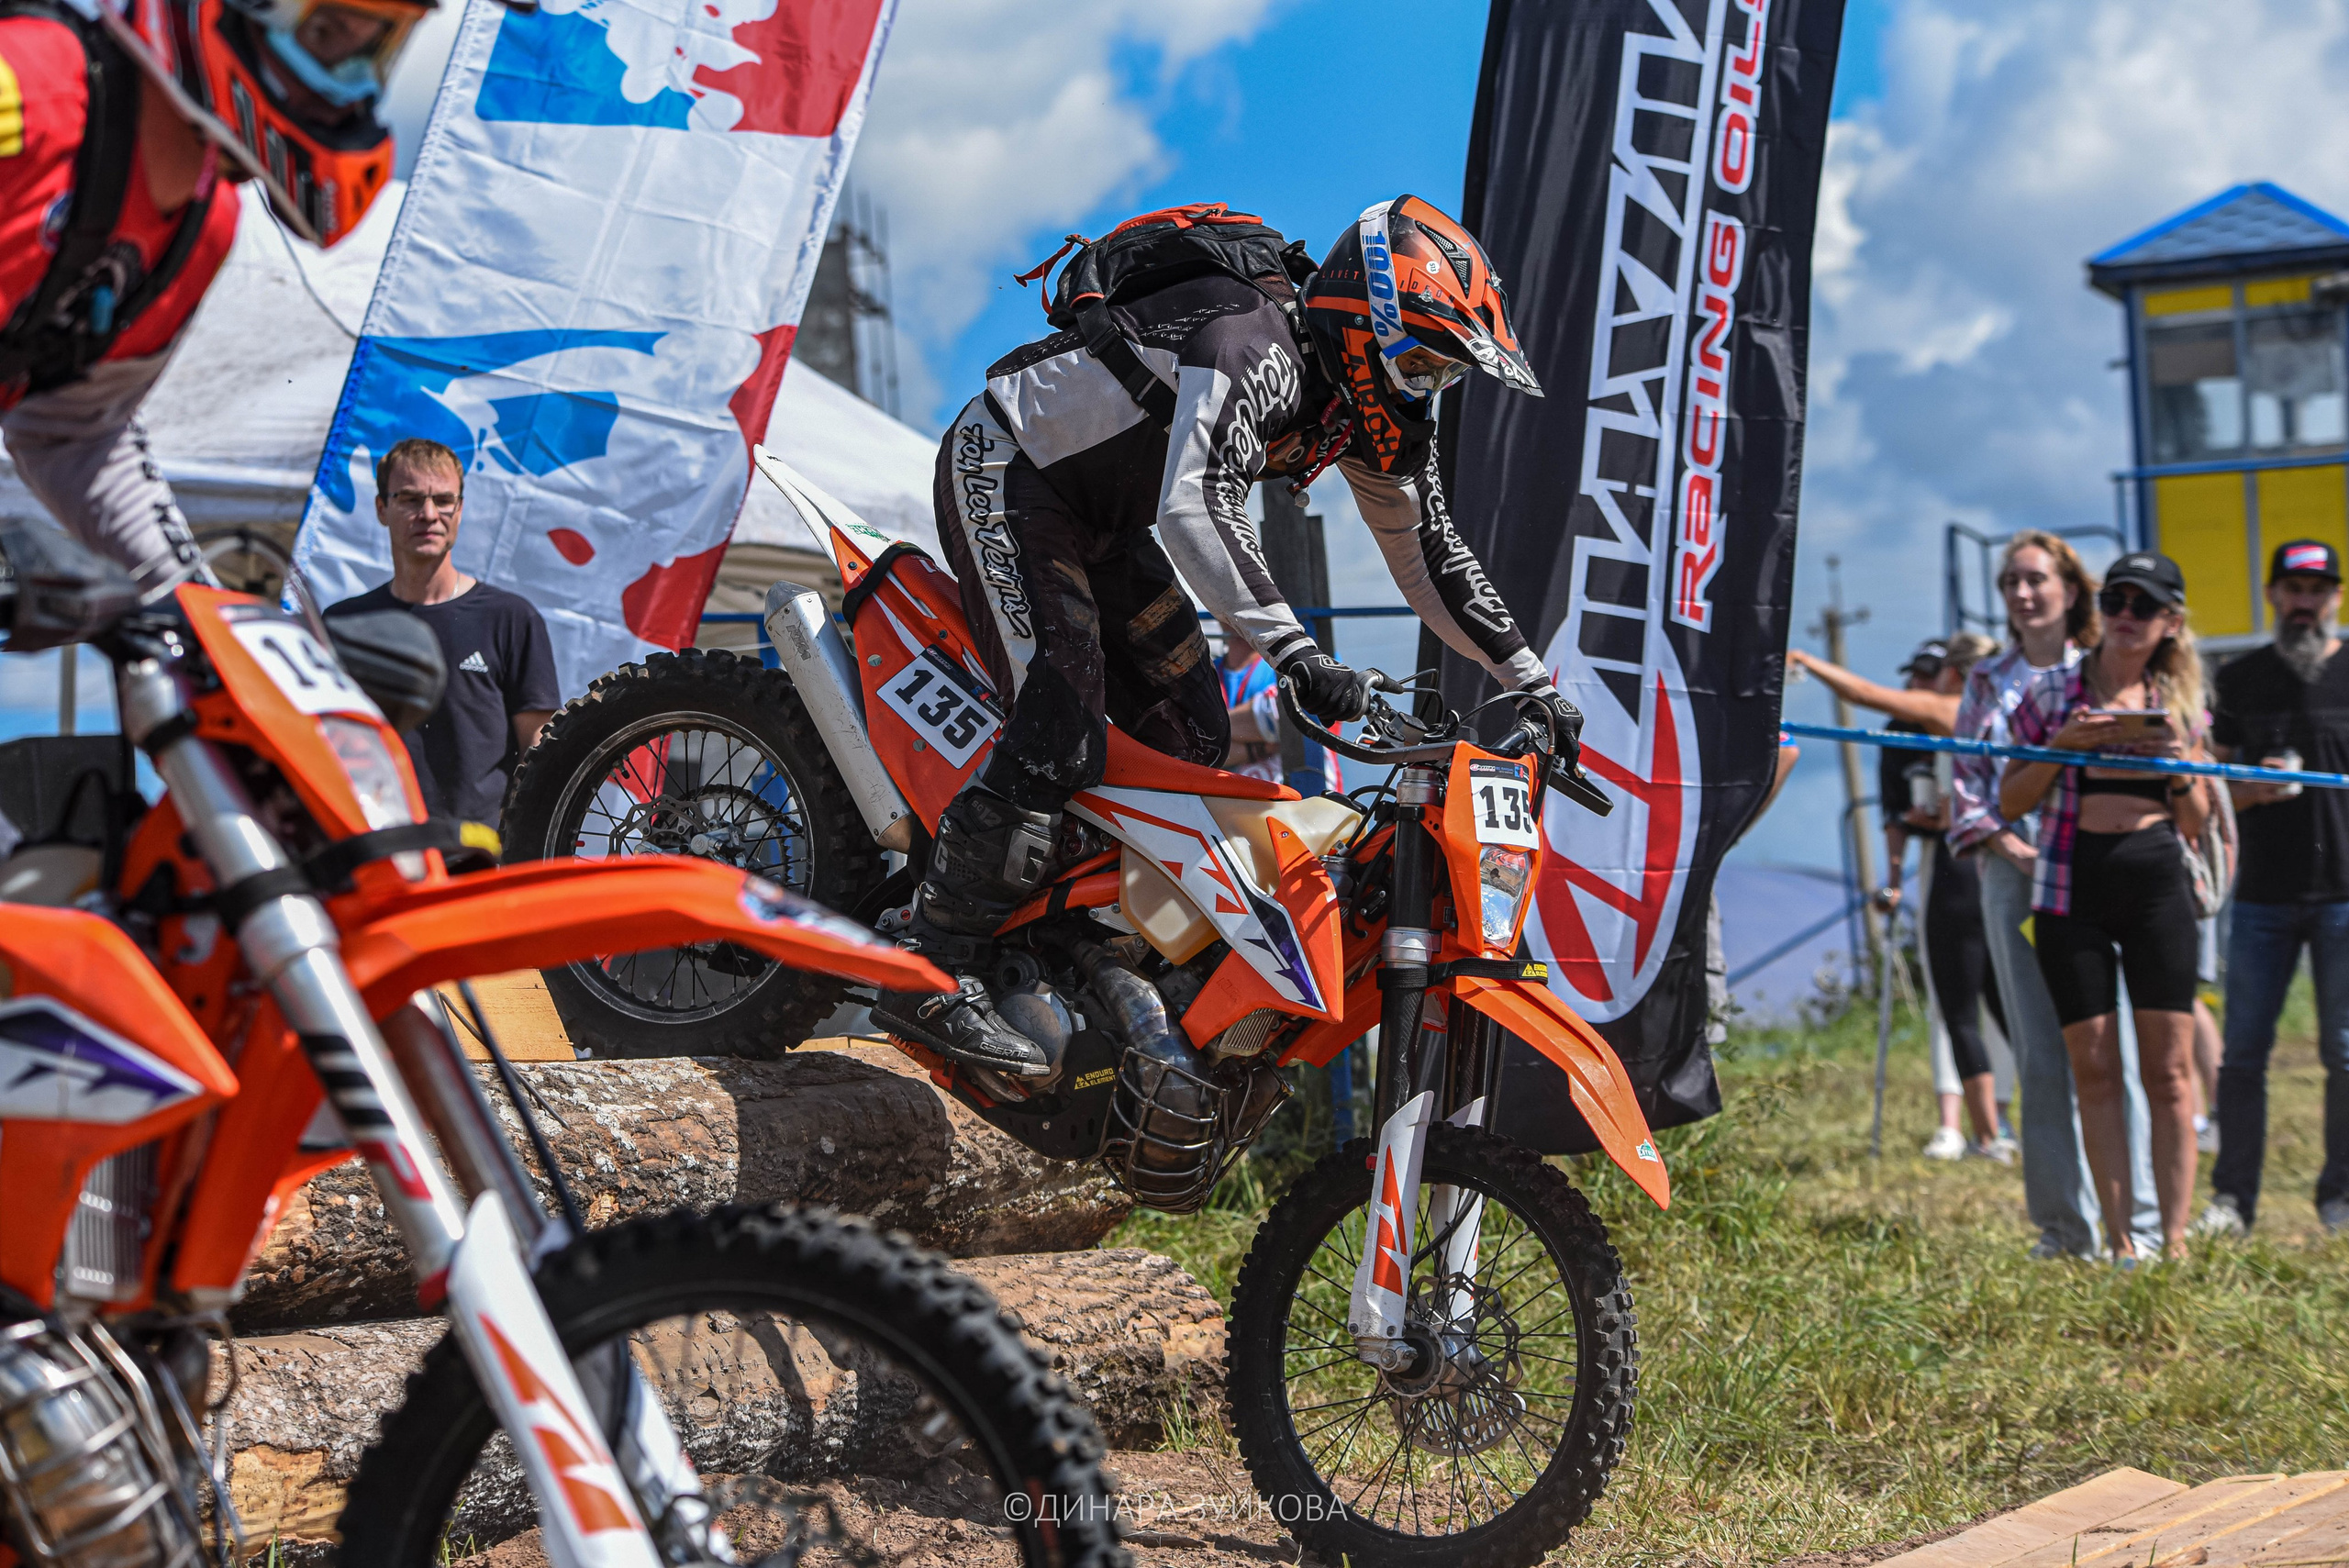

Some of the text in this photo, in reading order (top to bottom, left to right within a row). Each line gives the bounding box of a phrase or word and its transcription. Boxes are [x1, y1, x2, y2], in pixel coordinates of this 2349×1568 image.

[1714, 0, 1768, 194] OIL
[1362, 229, 1404, 337] 100%
[895, 669, 988, 750] 135
[1479, 785, 1532, 834] 135
[1085, 1067, 1115, 1080] ENDURO
